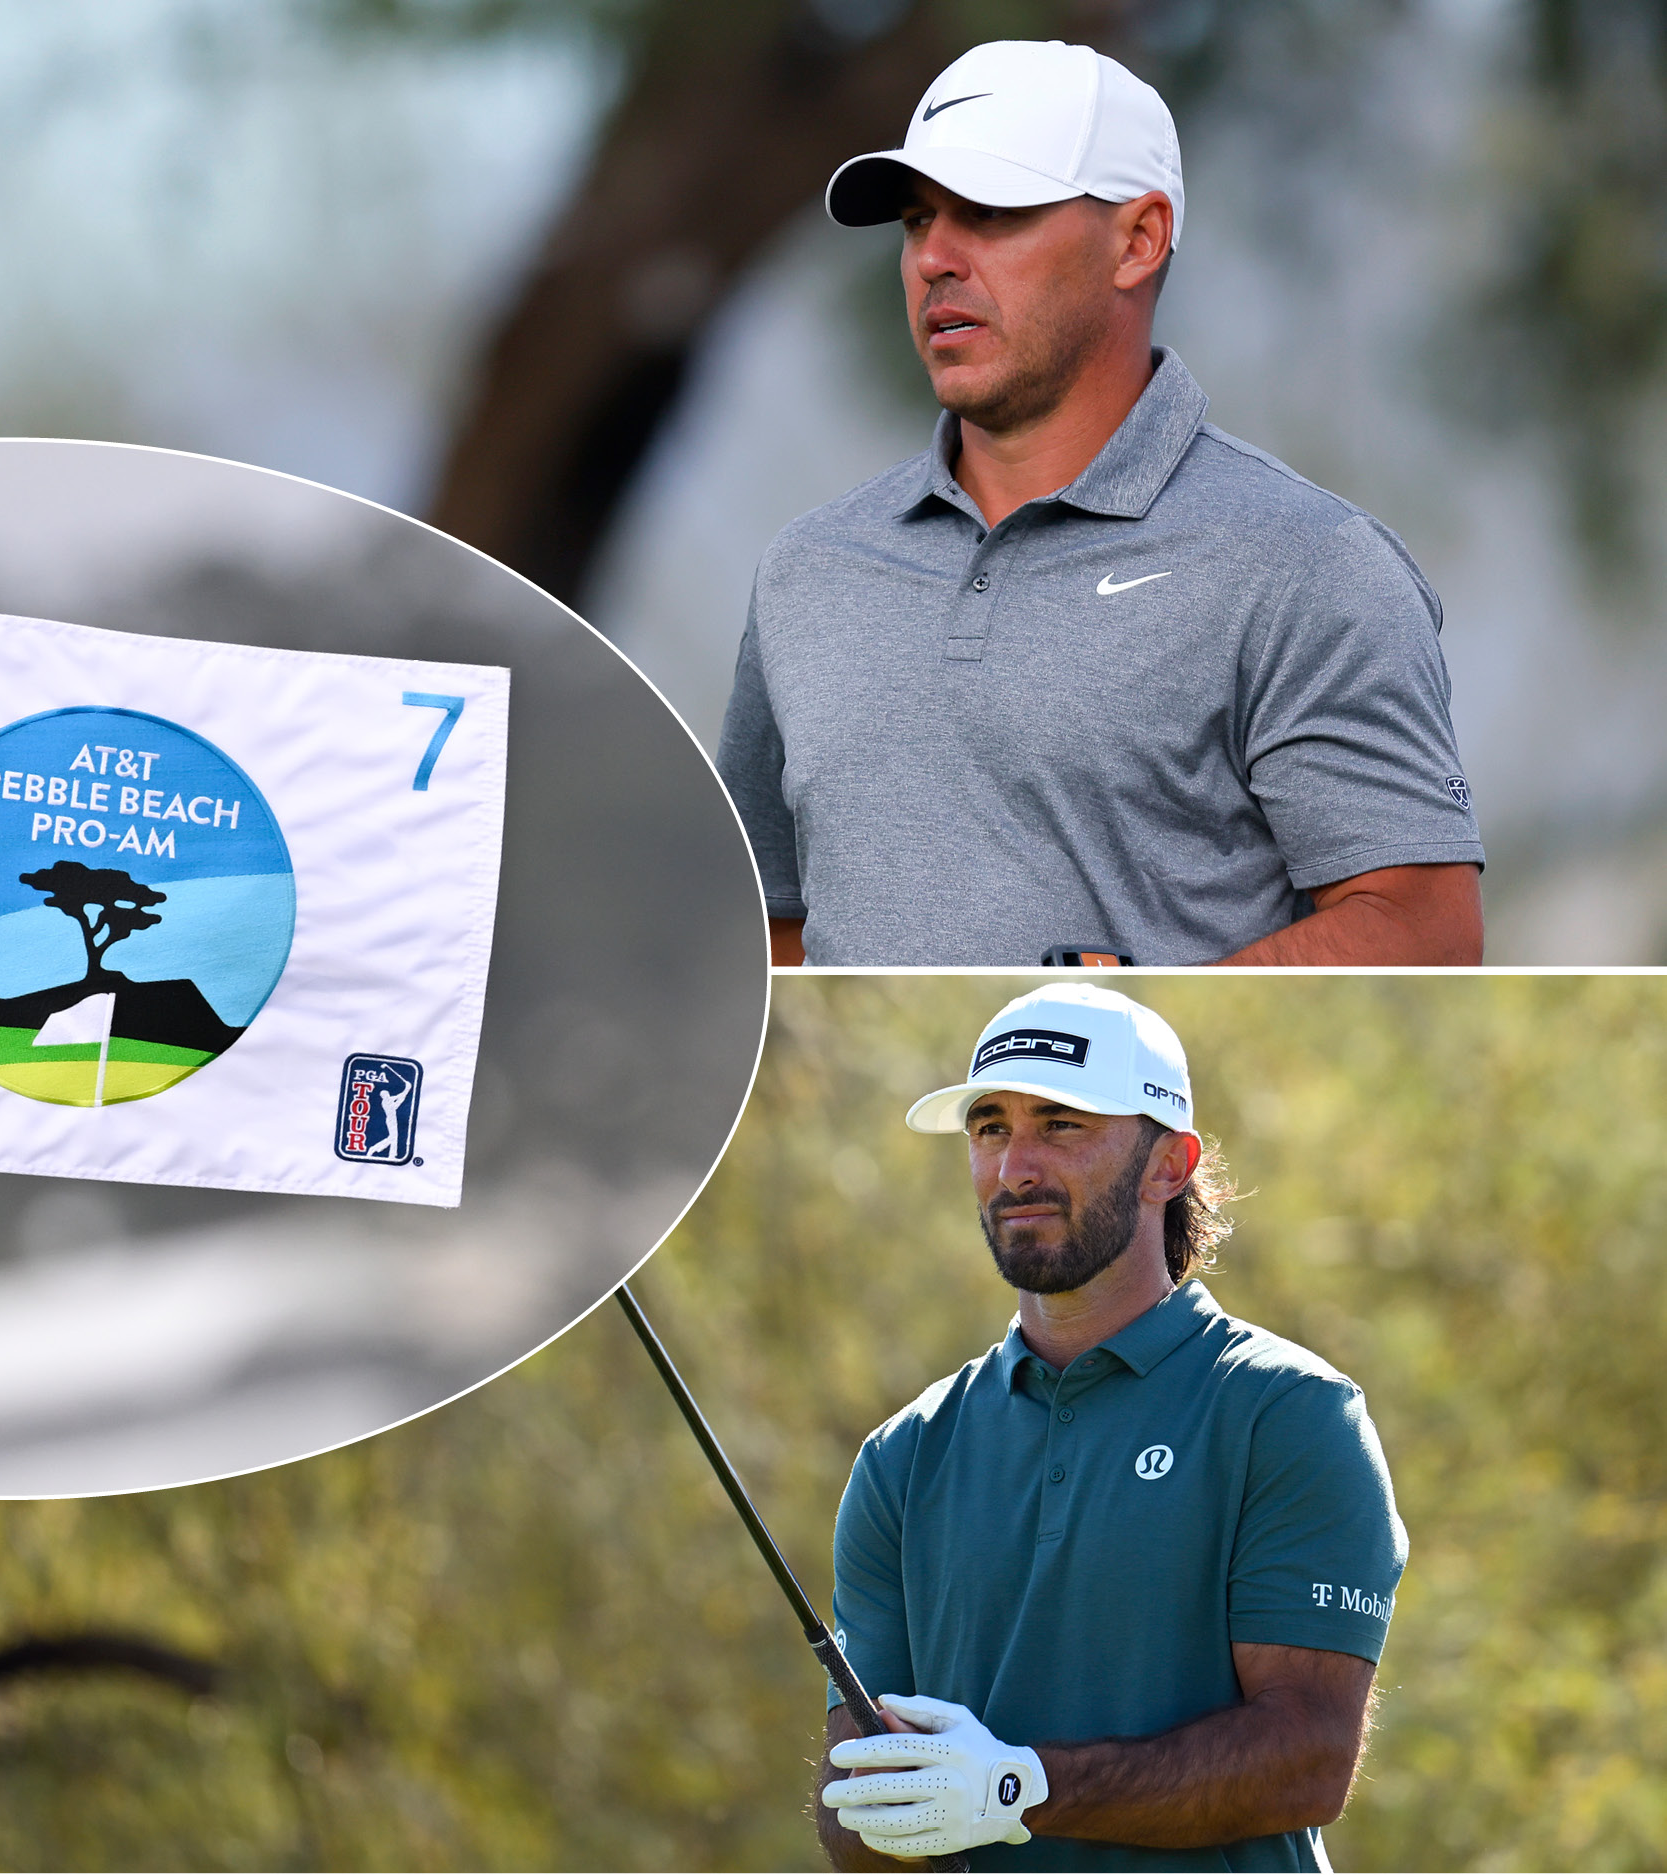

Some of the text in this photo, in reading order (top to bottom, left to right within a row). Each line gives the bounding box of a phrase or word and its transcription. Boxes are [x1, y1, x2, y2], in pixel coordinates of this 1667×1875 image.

[69, 743, 160, 781] AT&T
[402, 691, 465, 791] 7
[119, 786, 240, 829] BEACH
[31, 812, 176, 859] PRO-AM
[979, 1036, 1075, 1063] cobra
[353, 1069, 389, 1083] PGA
[346, 1081, 375, 1152] TOUR
